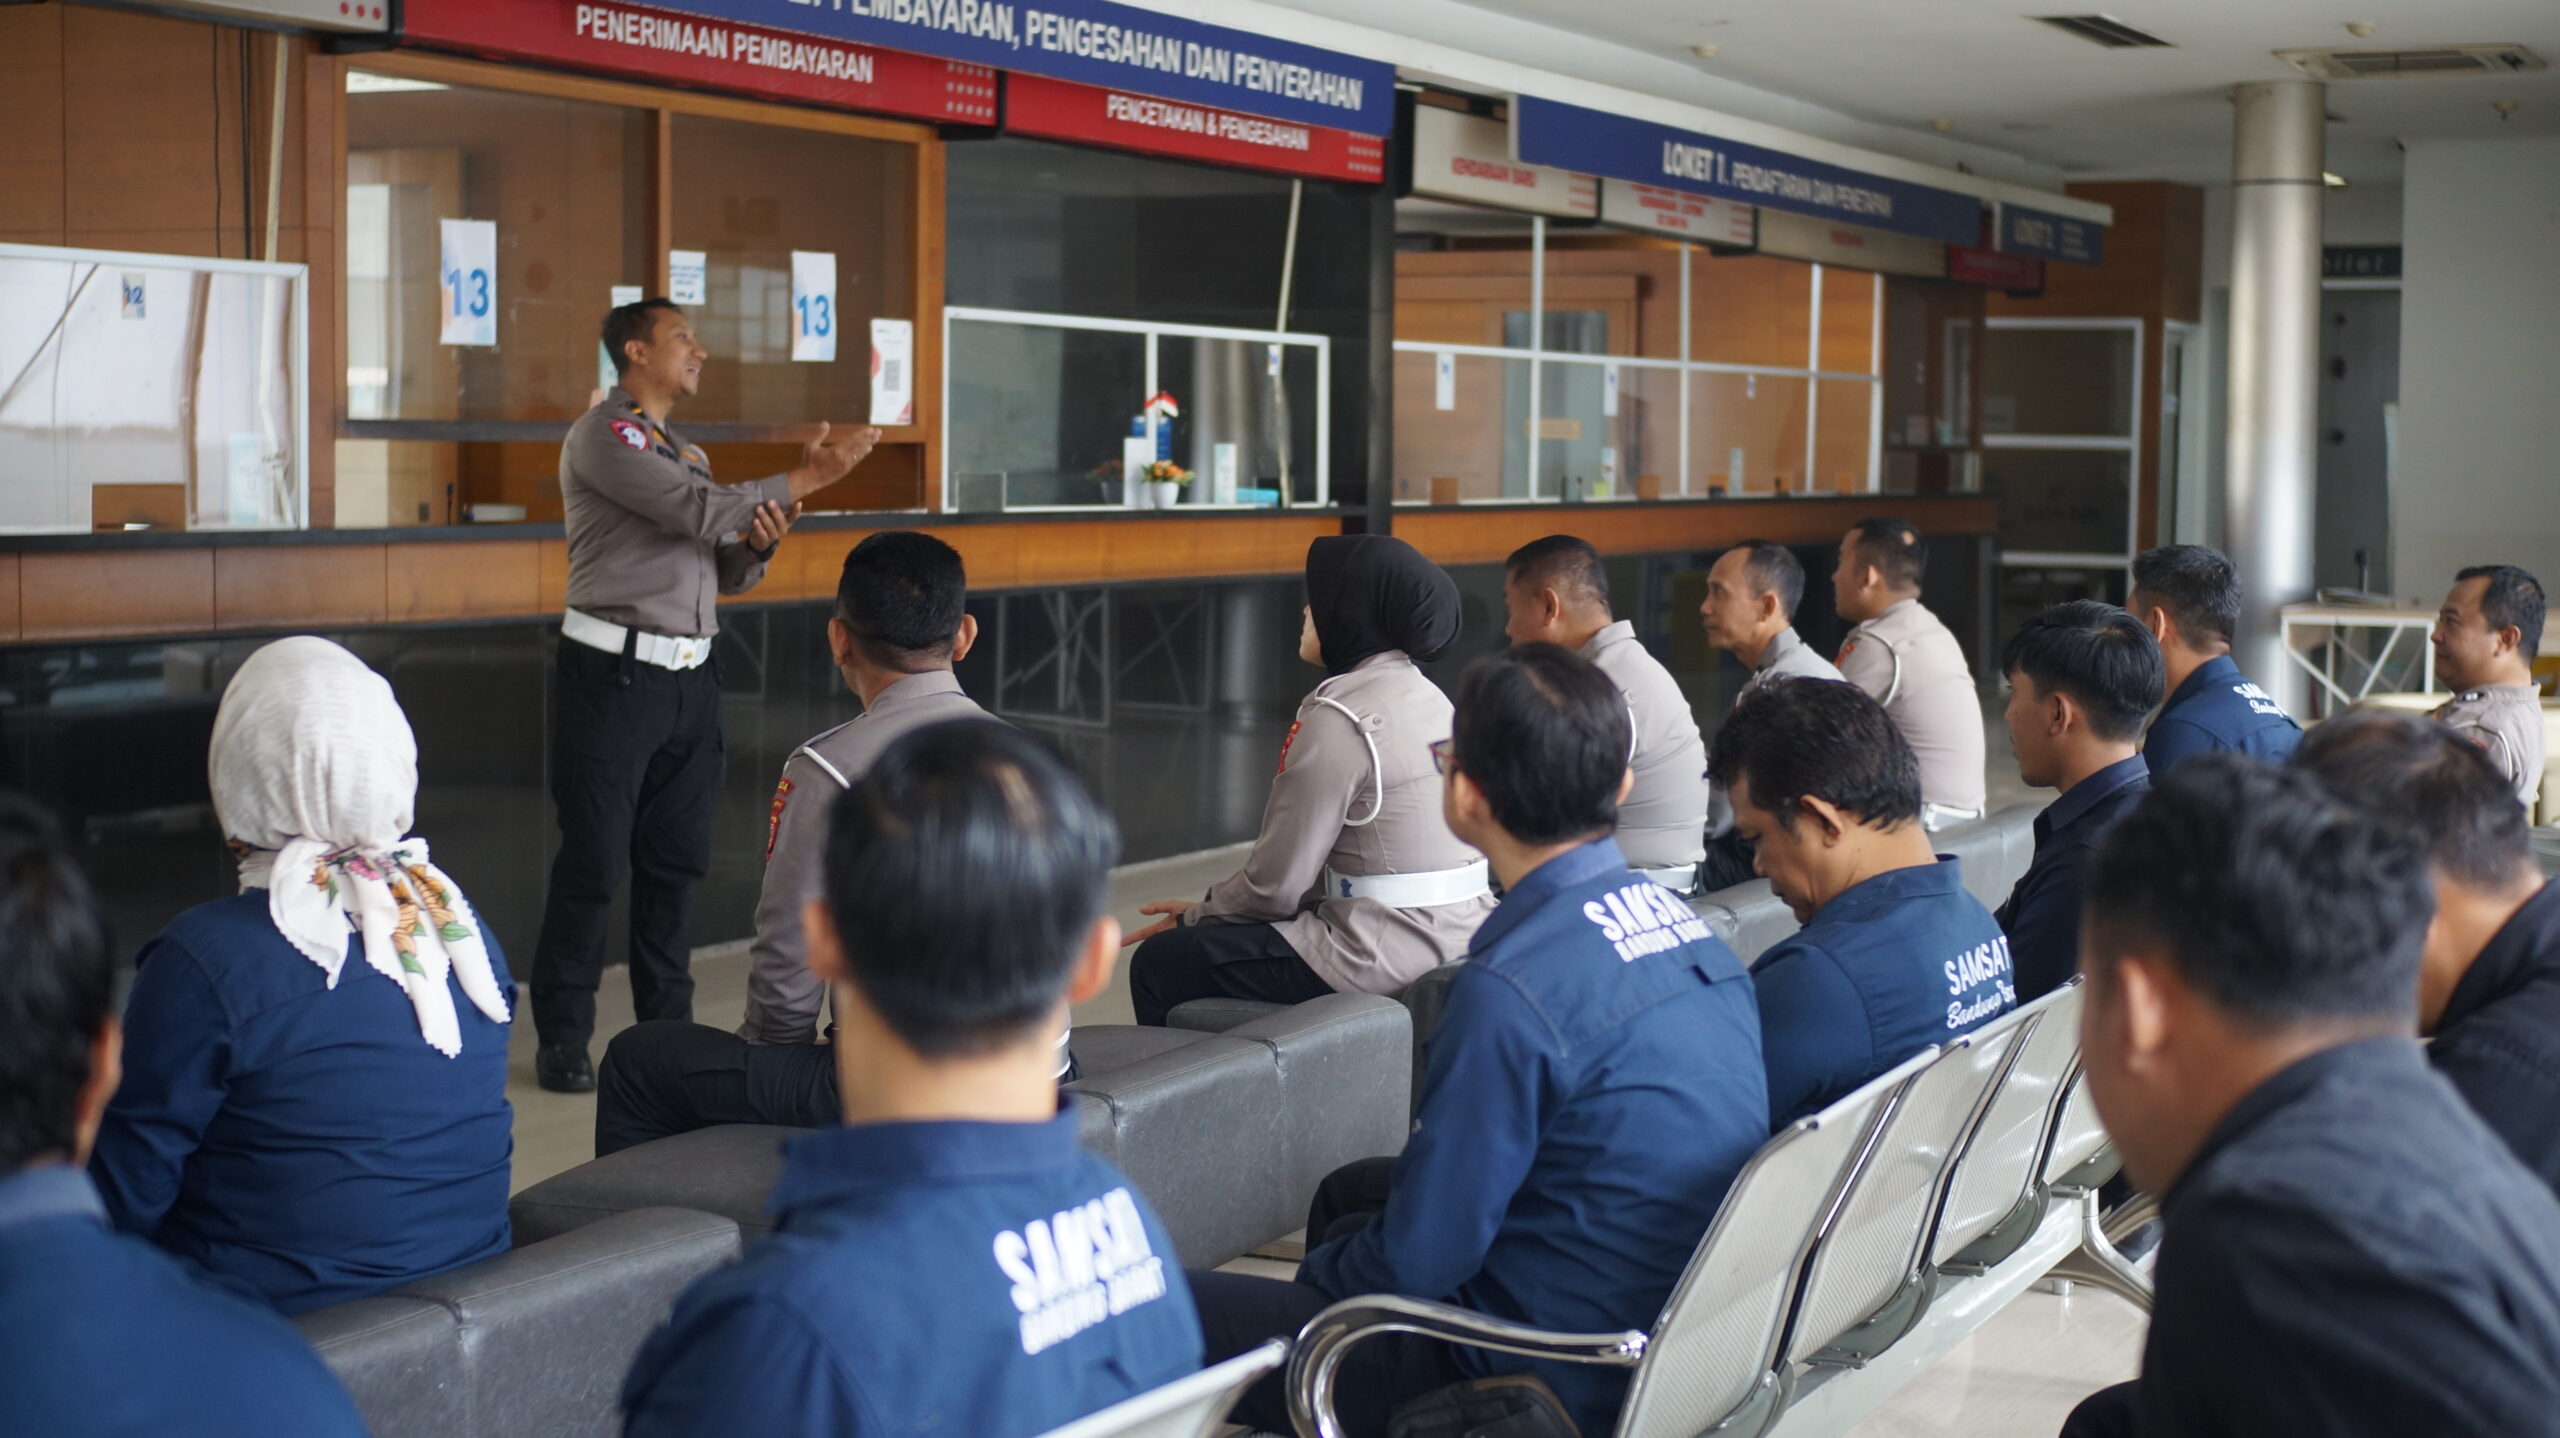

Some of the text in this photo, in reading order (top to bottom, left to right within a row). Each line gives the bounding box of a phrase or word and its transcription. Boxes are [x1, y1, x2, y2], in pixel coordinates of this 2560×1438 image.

[576, 4, 874, 84] PENERIMAAN PEMBAYARAN
[832, 0, 1364, 112] MBAYARAN, PENGESAHAN DAN PENYERAHAN
[1106, 94, 1309, 151] PENCETAKAN & PENGESAHAN
[1662, 140, 1714, 182] LOKET
[447, 267, 490, 318] 13
[797, 293, 831, 338] 13
[1944, 935, 2011, 996] SAMSAT
